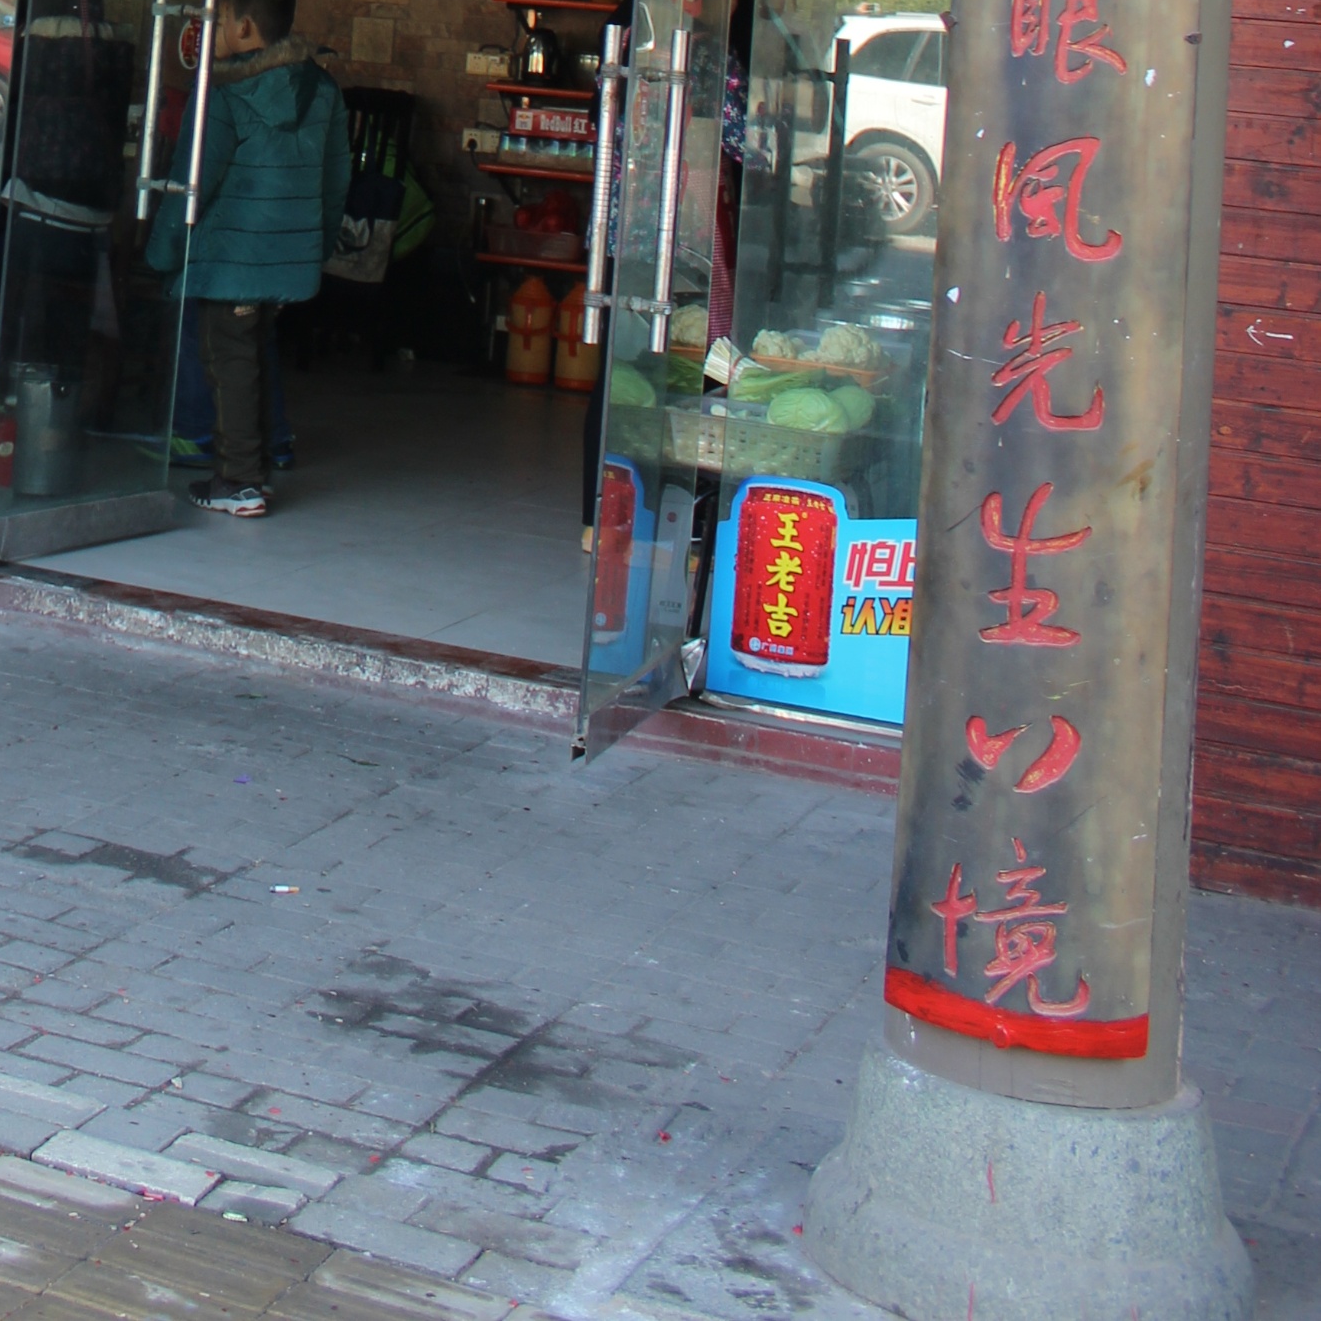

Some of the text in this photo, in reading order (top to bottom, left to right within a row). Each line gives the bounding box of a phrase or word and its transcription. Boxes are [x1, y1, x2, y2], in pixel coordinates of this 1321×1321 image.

[540, 114, 572, 133] RedBull
[573, 118, 596, 135] 红
[762, 510, 804, 638] 王老吉
